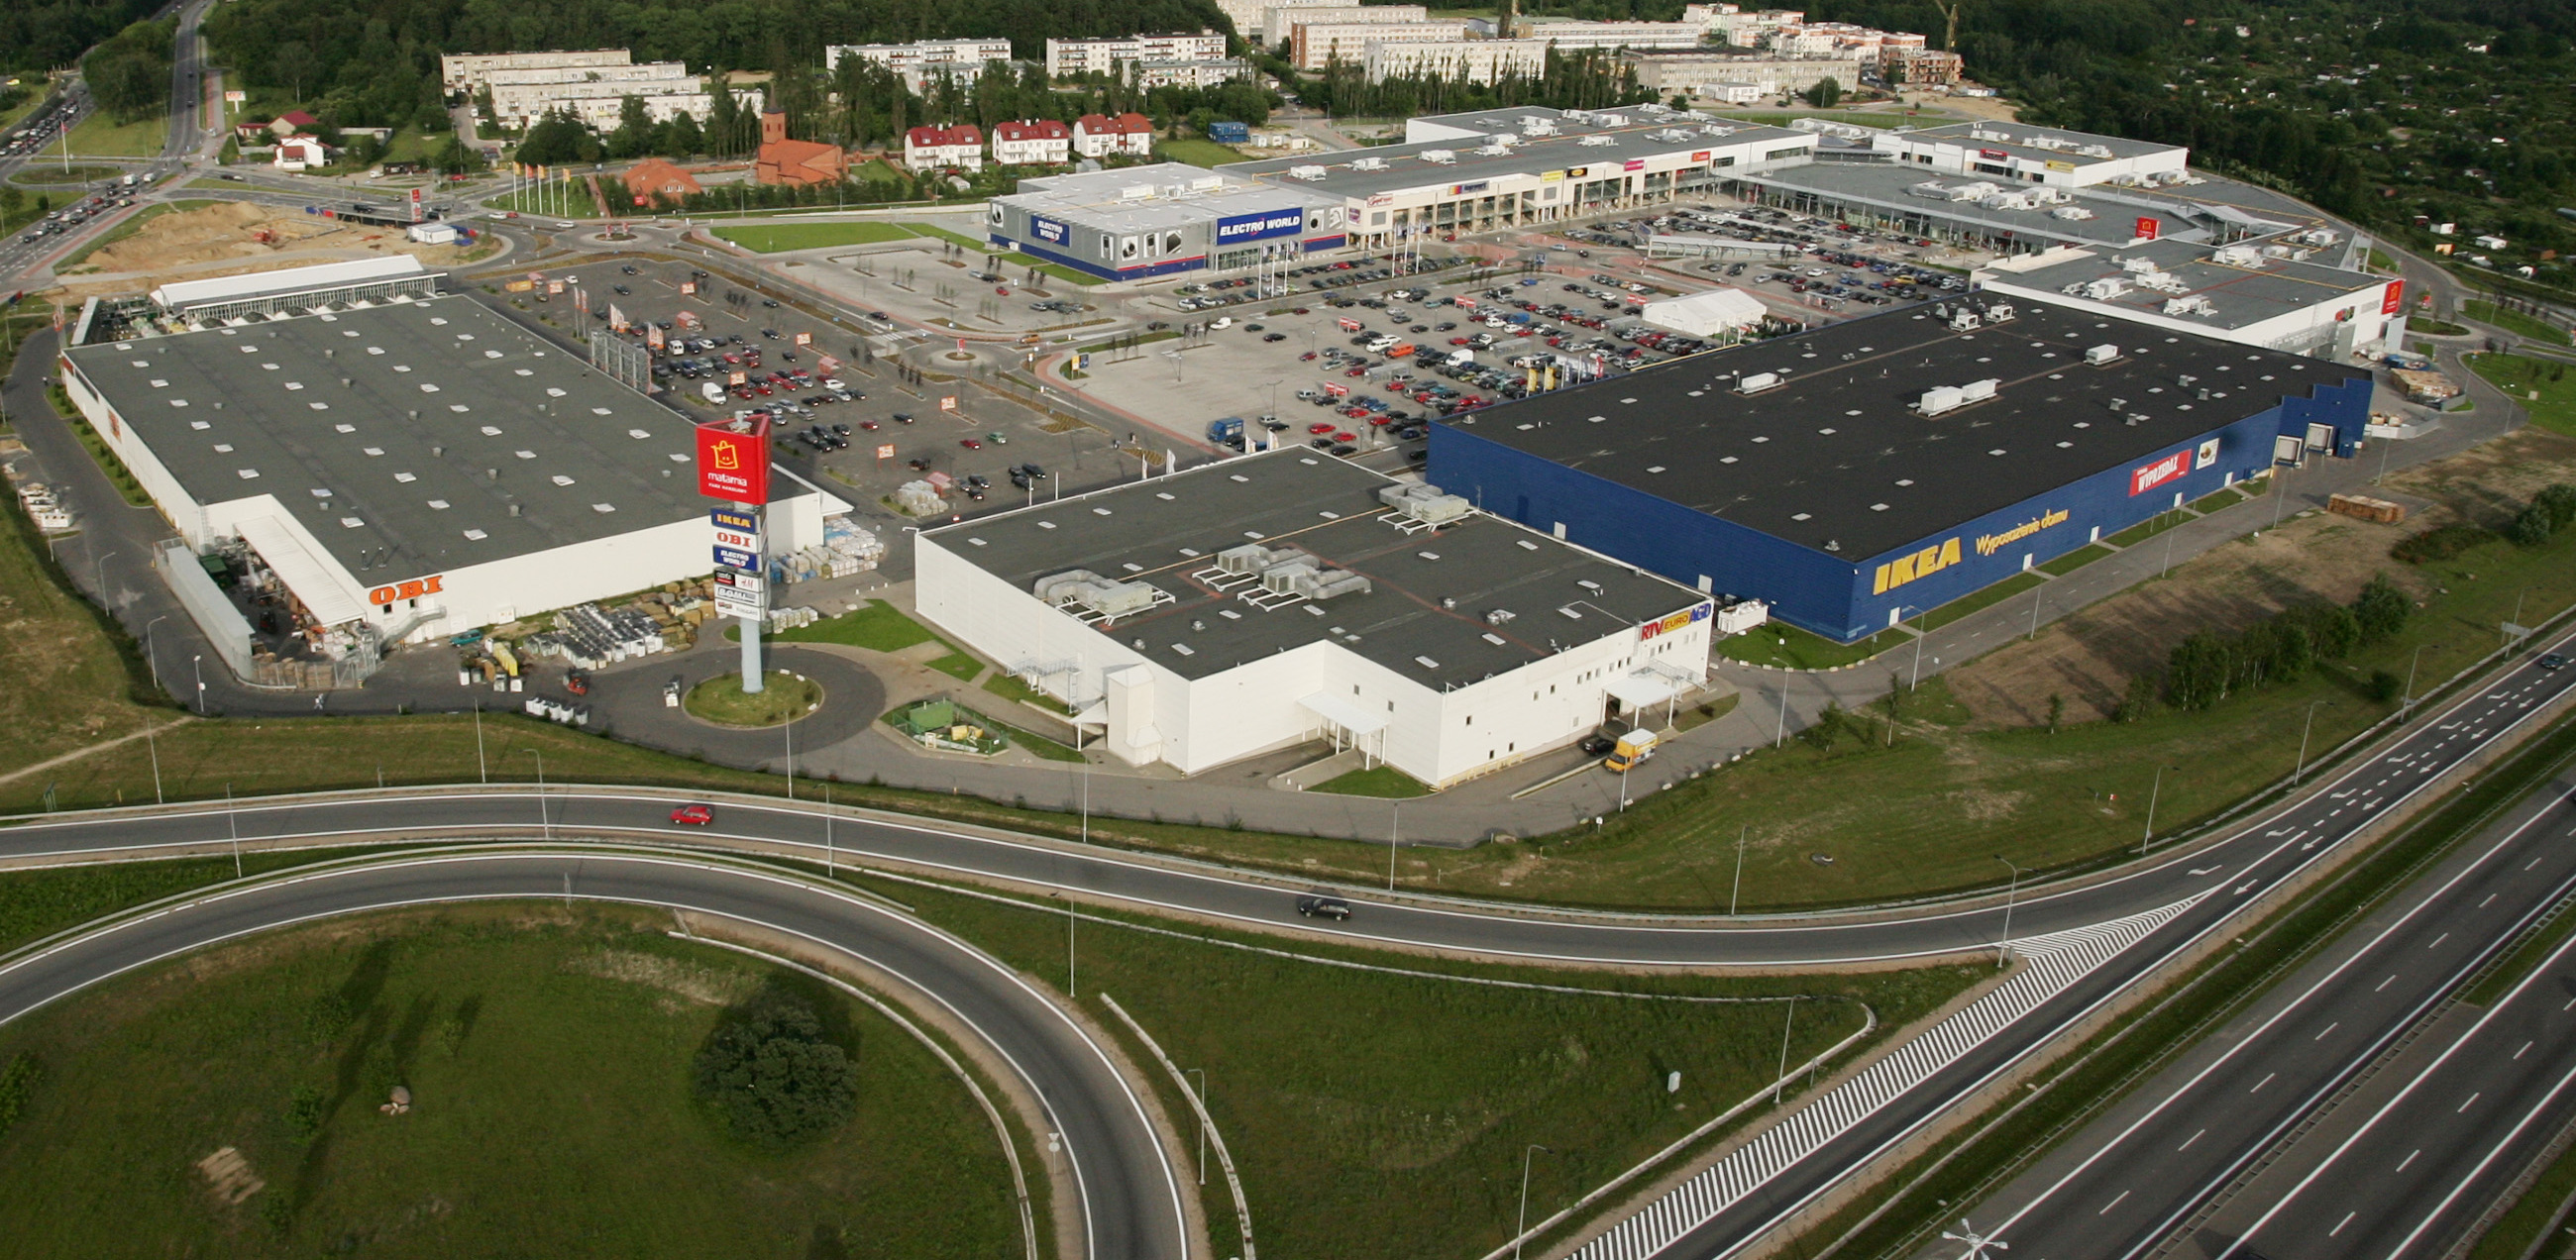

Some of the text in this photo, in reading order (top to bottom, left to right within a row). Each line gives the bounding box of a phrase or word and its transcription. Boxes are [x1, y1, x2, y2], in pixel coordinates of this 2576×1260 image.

[1220, 216, 1300, 236] ELECTRO WORLD
[716, 513, 752, 528] IKEA
[716, 532, 751, 548] OBI
[720, 550, 749, 562] ELECTRO
[1873, 536, 1962, 595] IKEA
[2041, 508, 2069, 529] domu
[723, 556, 746, 567] WORLD
[369, 576, 443, 606] OBI
[1641, 603, 1712, 642] RTV EURO AGD
